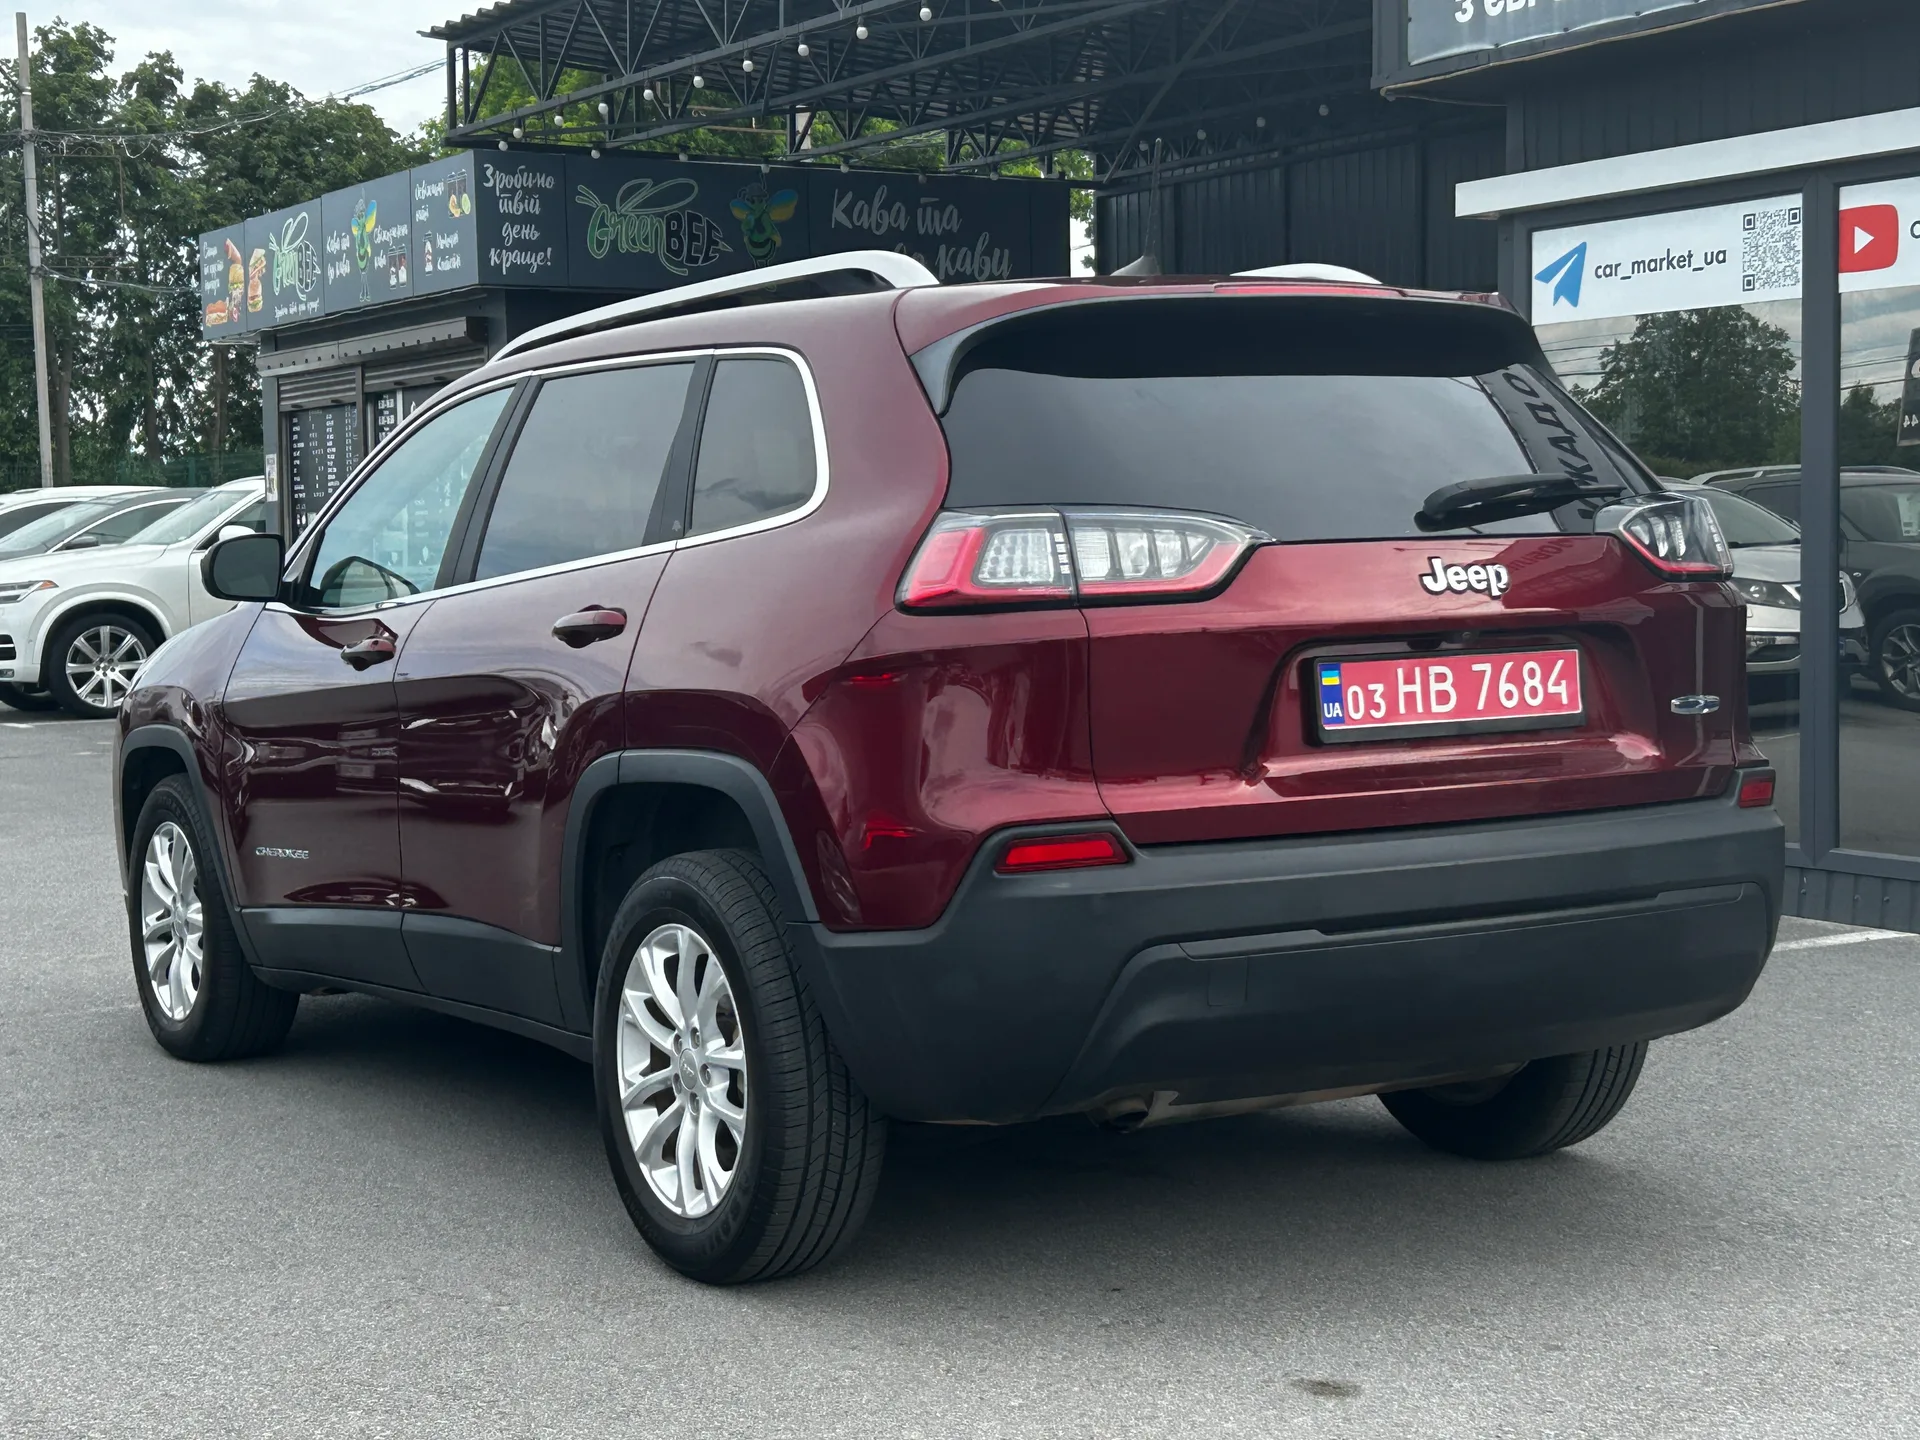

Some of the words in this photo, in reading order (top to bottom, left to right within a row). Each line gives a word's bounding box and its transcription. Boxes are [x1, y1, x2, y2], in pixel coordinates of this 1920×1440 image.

[482, 164, 556, 197] Зробимо
[498, 189, 542, 216] твій
[831, 184, 911, 236] Кава
[917, 197, 963, 236] та
[501, 222, 541, 247] день
[488, 247, 553, 276] краще!
[935, 231, 1014, 282] кави
[1594, 247, 1728, 281] car_market_ua
[1420, 556, 1511, 599] Jeep
[1323, 702, 1343, 718] UA
[1346, 683, 1387, 720] 03
[1396, 665, 1458, 715] HB
[1471, 659, 1569, 711] 7684
[255, 846, 310, 860] CHEROKEE
